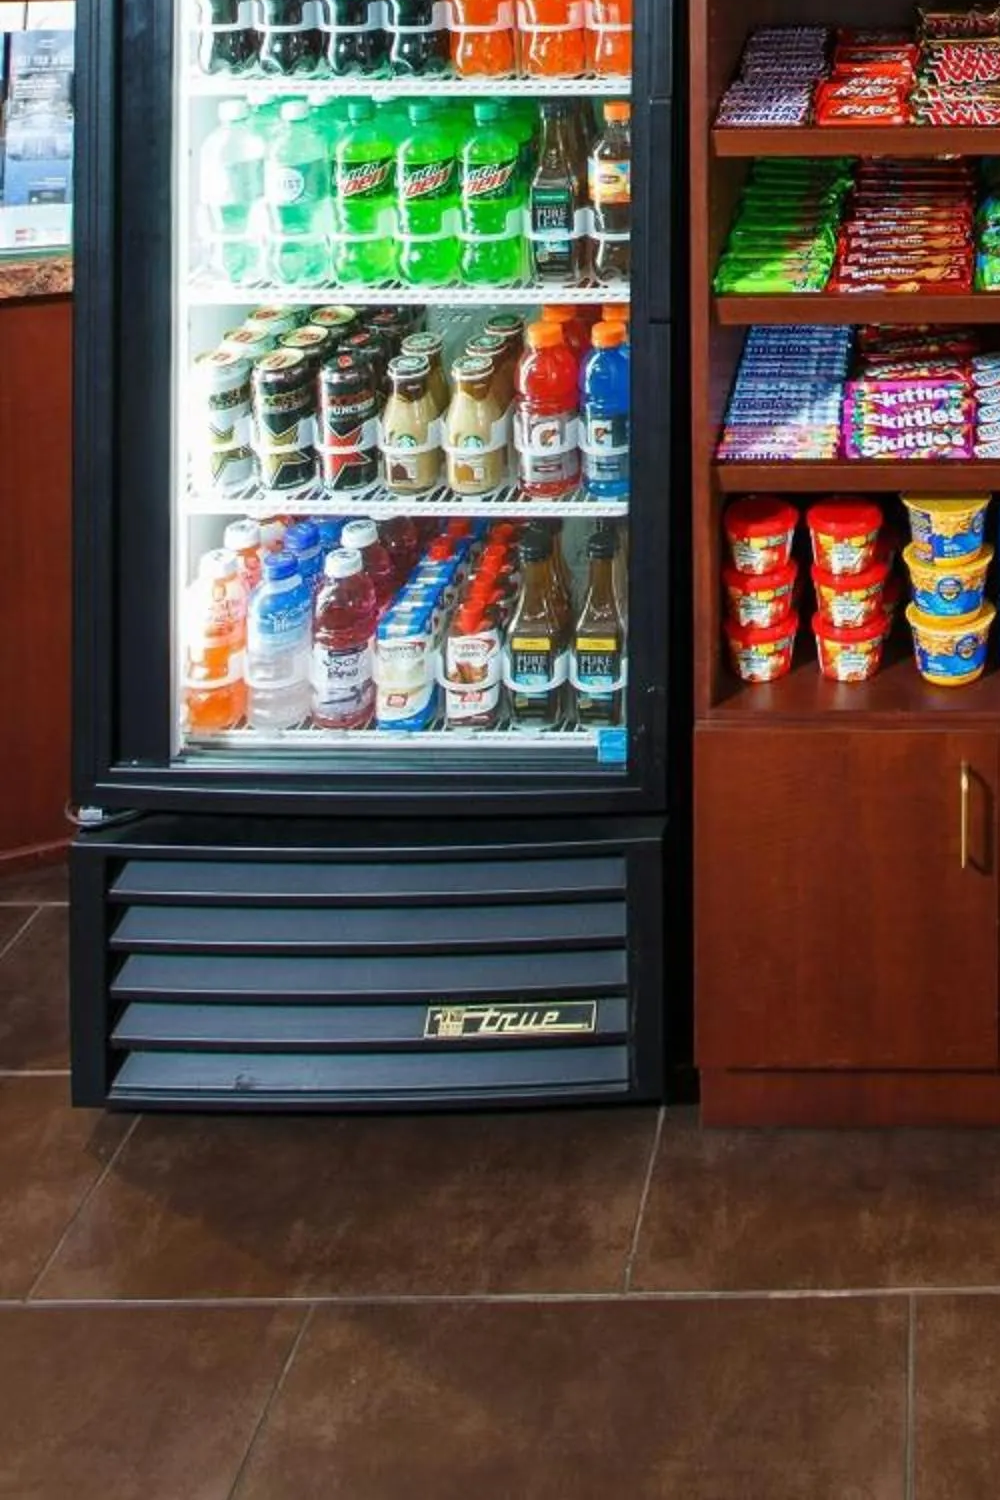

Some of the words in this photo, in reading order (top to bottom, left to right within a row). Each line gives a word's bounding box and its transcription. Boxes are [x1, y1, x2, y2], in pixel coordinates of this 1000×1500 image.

[861, 431, 966, 456] Skittles
[516, 654, 548, 666] PURE
[580, 654, 613, 666] PURE
[474, 1007, 564, 1032] true
